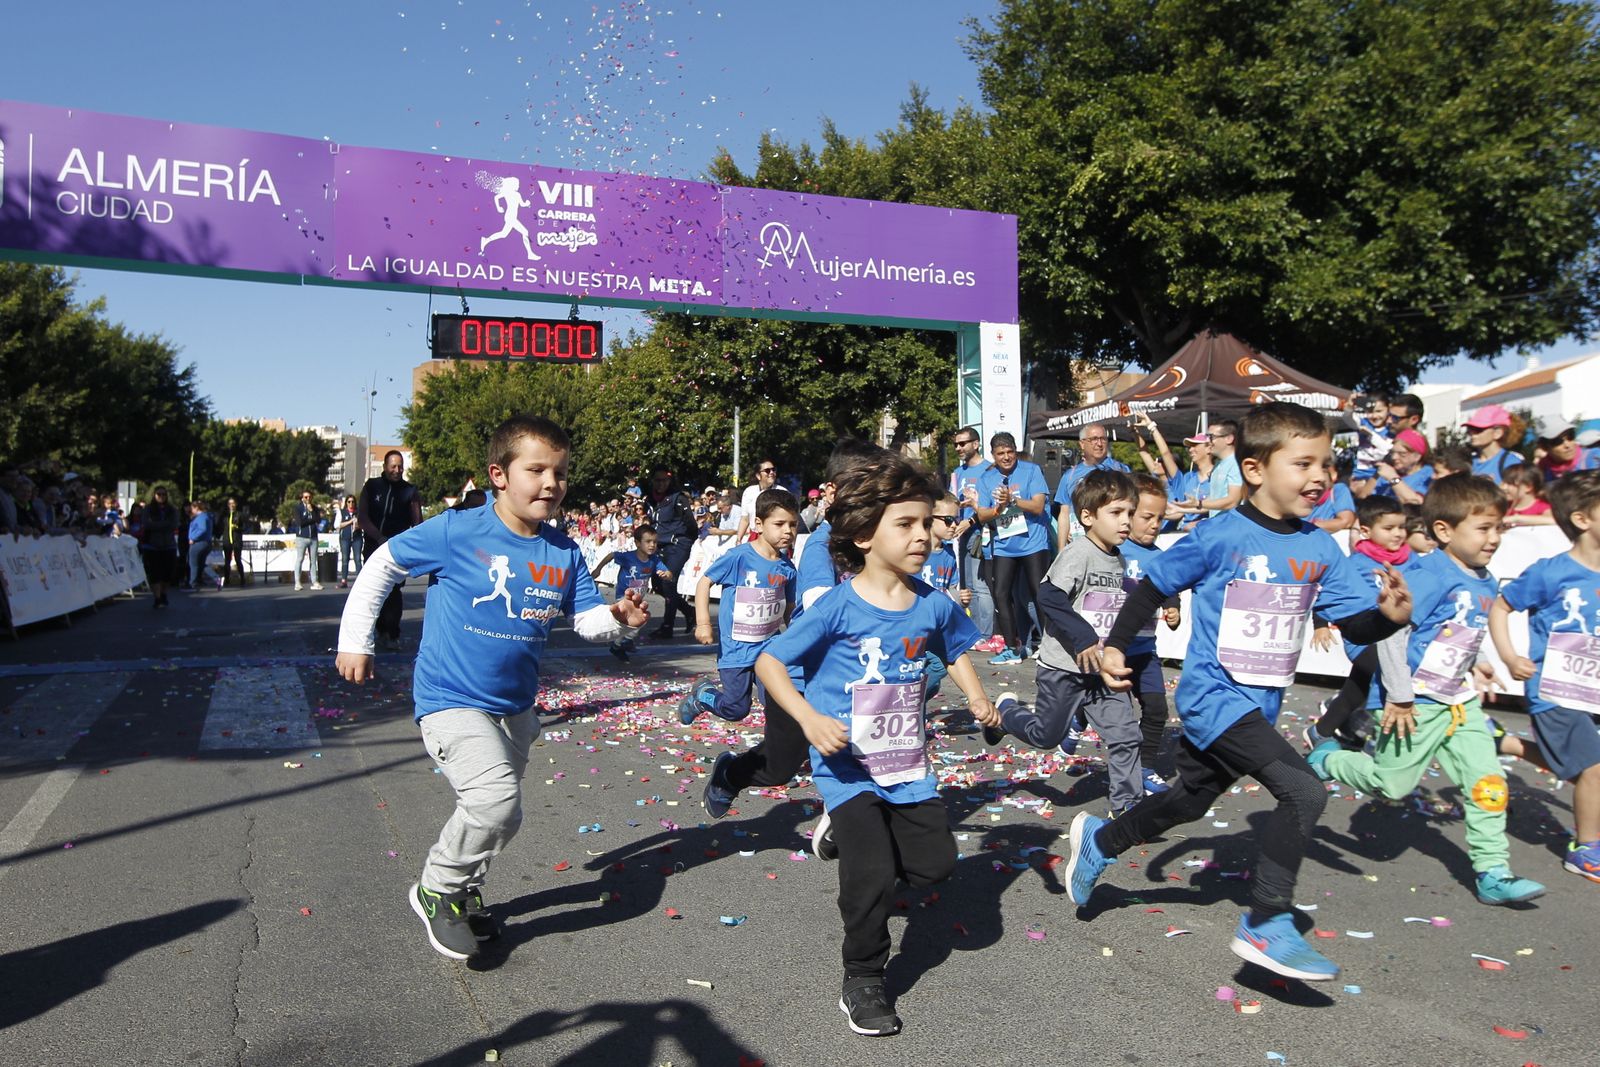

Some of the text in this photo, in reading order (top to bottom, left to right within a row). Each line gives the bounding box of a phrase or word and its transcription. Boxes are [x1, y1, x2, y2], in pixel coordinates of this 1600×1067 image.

[57, 147, 281, 206] ALMERÍA
[537, 180, 594, 208] VIII
[56, 190, 174, 224] CIUDAD
[537, 208, 596, 223] CARRERA
[348, 254, 712, 296] LA IGUALDAD ES NUESTRA META.
[461, 319, 596, 359] 00:00:00
[745, 602, 781, 618] 3110
[463, 624, 473, 632] LA
[474, 626, 512, 640] IGUALDAD
[1263, 641, 1293, 650] DANIEL
[888, 738, 914, 747] PABLO
